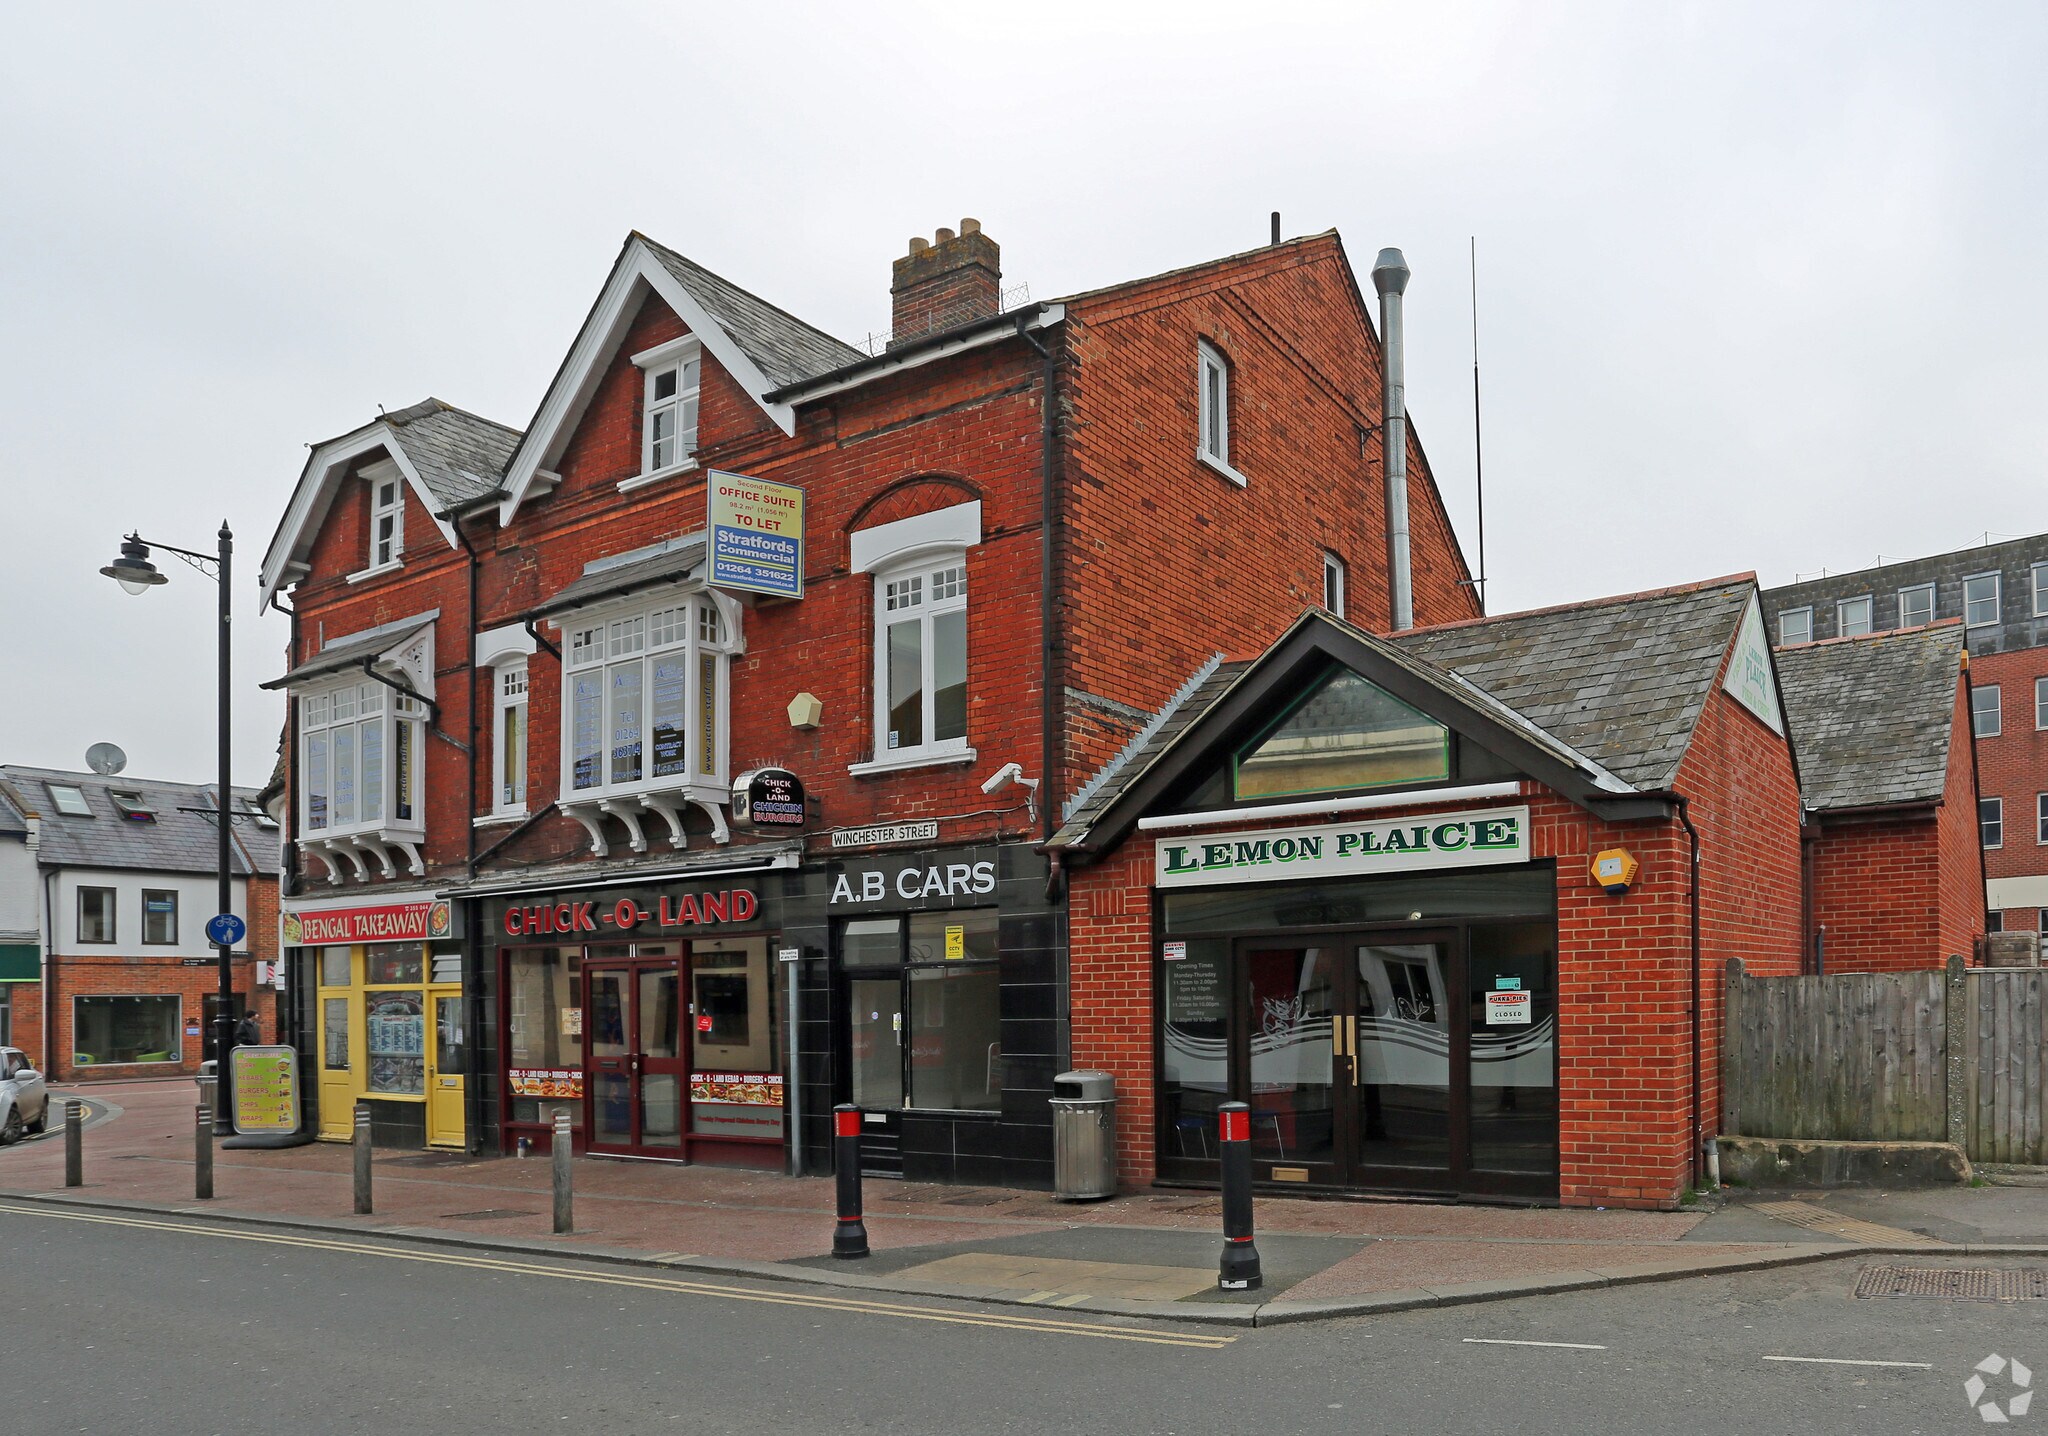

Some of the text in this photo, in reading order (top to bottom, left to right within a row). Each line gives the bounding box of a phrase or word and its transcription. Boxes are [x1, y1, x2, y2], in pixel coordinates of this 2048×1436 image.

[737, 480, 782, 494] Second Floor
[719, 486, 795, 508] OFFICE SUITE
[729, 501, 744, 510] 98.2
[735, 514, 781, 531] TO LET
[718, 530, 794, 554] Stratfords
[718, 544, 794, 564] Commercial
[717, 562, 794, 581] 01264 351622
[717, 572, 794, 588] www.stratfords-commercial.co.uk
[620, 711, 634, 723] Tel
[615, 727, 639, 741] 01264
[764, 779, 791, 787] CHICK
[753, 801, 803, 813] CHICKEN
[753, 812, 803, 824] BURGERS
[834, 824, 935, 846] WINCHESTER STREET
[1164, 817, 1520, 874] LEMON PLAICE
[830, 862, 995, 904] A.B CARS
[504, 901, 596, 936] CHICK
[659, 889, 758, 927] LAND
[303, 911, 427, 940] BENGAL TAKEAWAY
